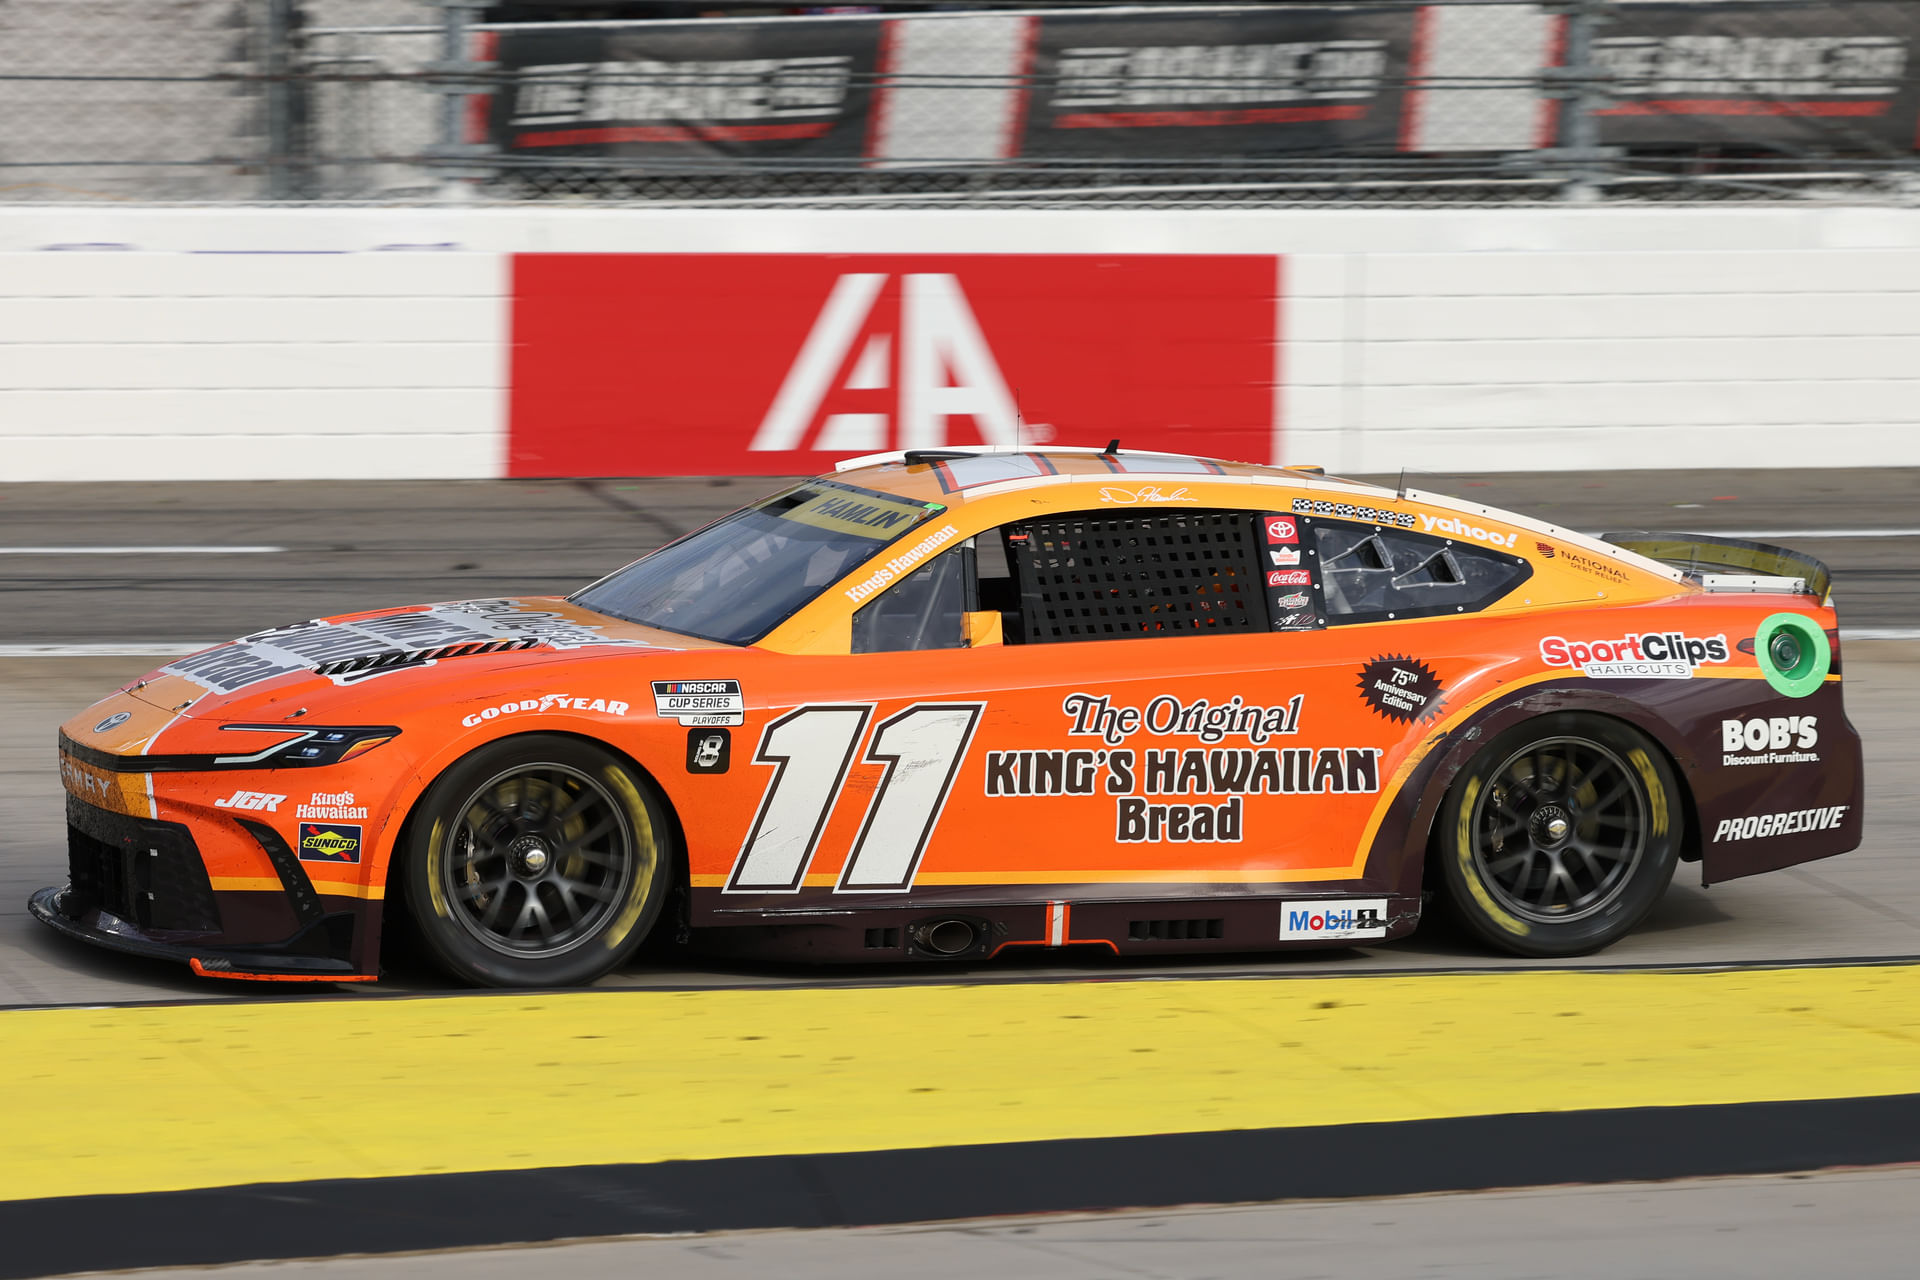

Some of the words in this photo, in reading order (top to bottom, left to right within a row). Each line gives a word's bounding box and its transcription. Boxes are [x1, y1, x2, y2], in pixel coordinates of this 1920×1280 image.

[810, 497, 910, 529] HAMLIN
[1418, 513, 1518, 548] yahoo!
[844, 569, 894, 603] King's
[885, 524, 959, 575] Hawaiian
[1560, 550, 1630, 582] NATIONAL
[1570, 562, 1593, 575] DEBT
[1595, 570, 1623, 584] RELIEF
[1541, 633, 1728, 668] SportClips
[1589, 664, 1686, 675] HAIRCUTS
[668, 698, 691, 708] CUP
[692, 697, 731, 708] SERIES
[681, 683, 727, 693] NASCAR
[1374, 679, 1427, 706] Anniversary
[1382, 693, 1413, 711] Edition
[462, 694, 629, 727] GOODYEAR
[692, 716, 731, 724] PLAYOFFS
[1064, 694, 1140, 744] The
[1146, 694, 1303, 744] Original
[1722, 716, 1818, 751] BOB'S
[698, 735, 723, 767] 8
[1723, 753, 1769, 766] Discount
[986, 750, 1136, 796] KING'S
[1145, 748, 1380, 795] HAWAIIAN
[214, 790, 287, 812] JGR
[295, 804, 368, 819] Hawaiian
[310, 791, 354, 806] King's
[721, 700, 988, 895] 11
[1116, 796, 1243, 842] Bread
[1712, 805, 1846, 843] PROGRESSIVE
[304, 838, 357, 849] SUNOCO
[1289, 909, 1352, 931] Mobil
